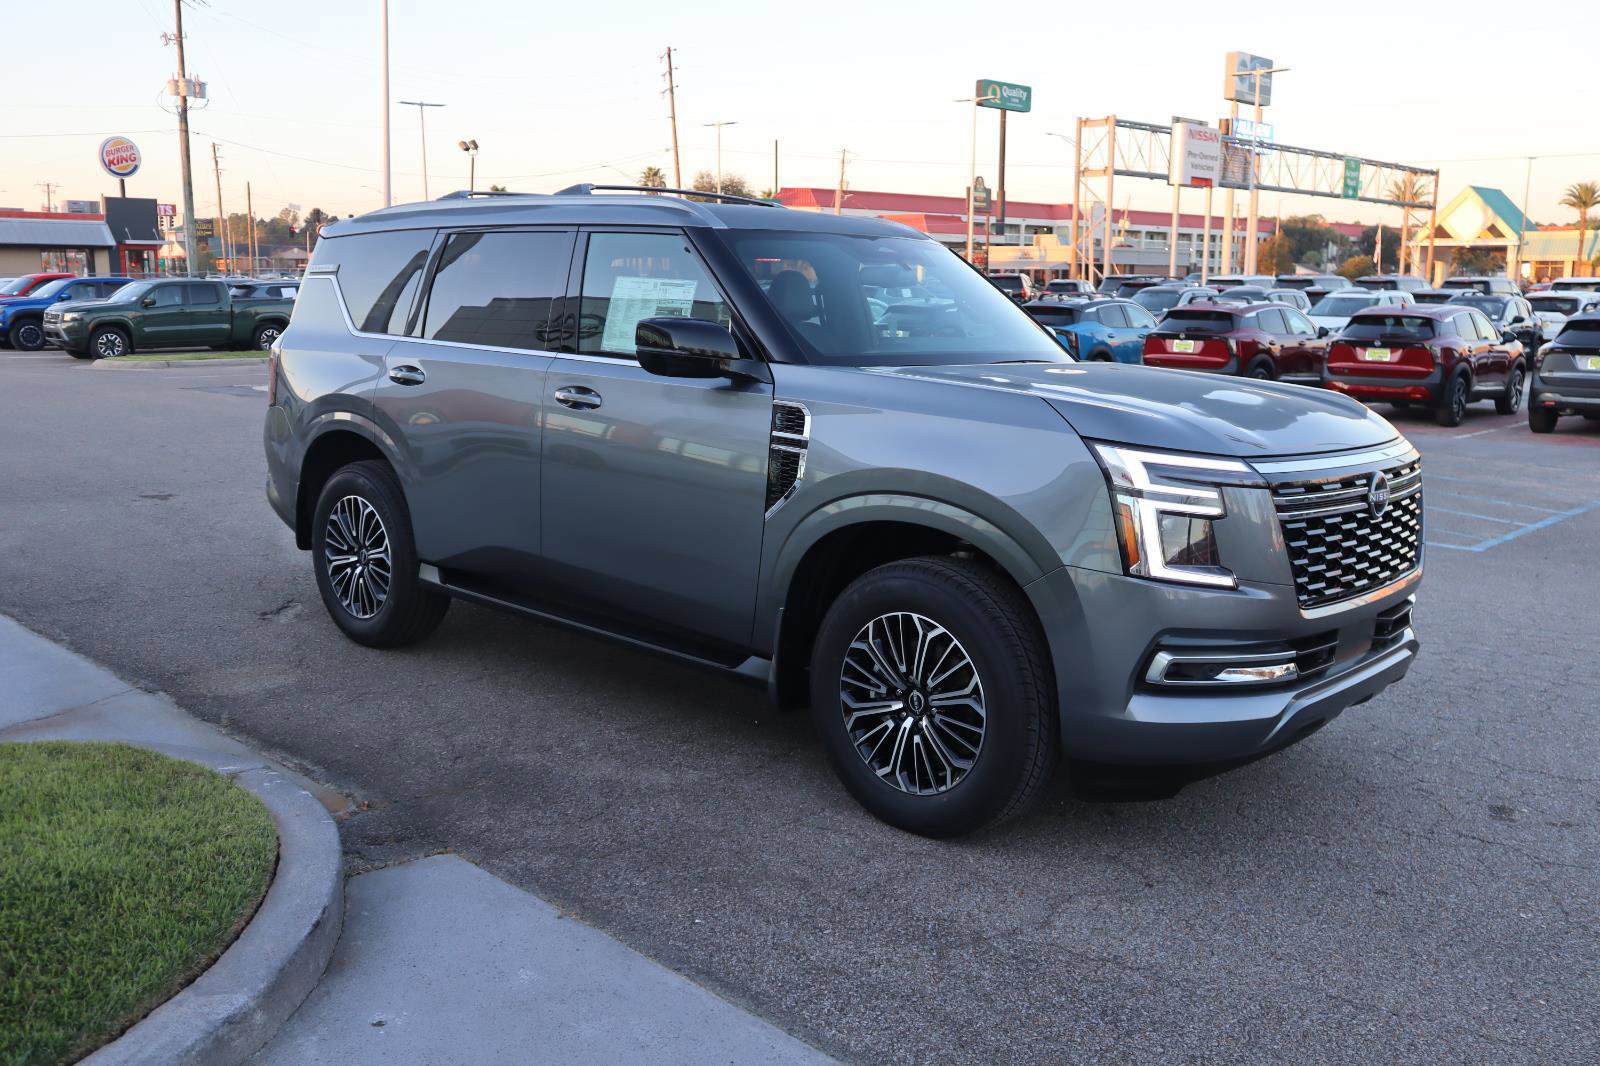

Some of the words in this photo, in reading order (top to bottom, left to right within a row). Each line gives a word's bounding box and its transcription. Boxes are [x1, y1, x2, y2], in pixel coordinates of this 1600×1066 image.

[1002, 85, 1027, 101] Quality
[1188, 127, 1219, 143] NISSAN
[105, 144, 135, 157] BURGER
[1187, 150, 1218, 162] Pre-Owned
[107, 152, 137, 167] KING
[1190, 161, 1214, 172] Vehicles
